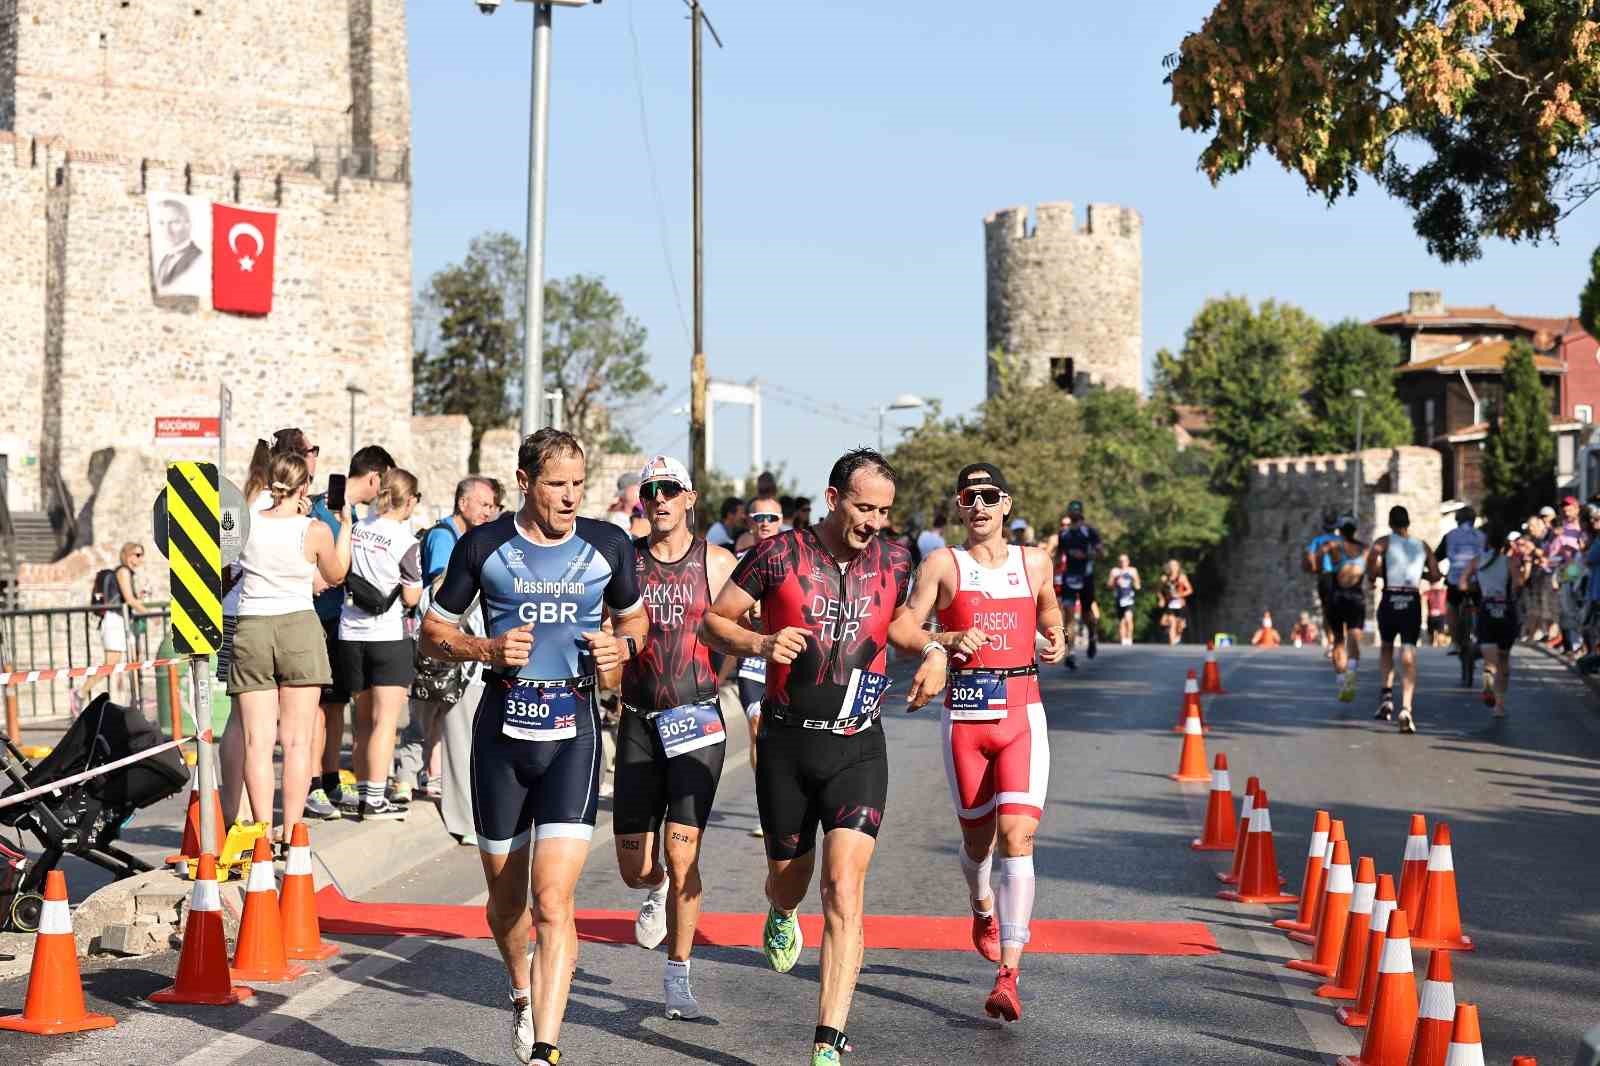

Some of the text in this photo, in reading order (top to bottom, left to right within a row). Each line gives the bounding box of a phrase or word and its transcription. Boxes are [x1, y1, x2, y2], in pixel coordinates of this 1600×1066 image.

[352, 526, 391, 546] AUSTRIA
[514, 577, 585, 598] Massingham
[643, 583, 693, 604] AKKAN
[518, 601, 578, 624] GBR
[649, 604, 685, 625] TUR
[811, 595, 872, 620] DENIZ
[818, 620, 860, 641] TUR
[973, 612, 1018, 632] PIASECKI
[861, 674, 880, 714] 3155
[952, 687, 984, 701] 3024
[506, 699, 550, 718] 3380
[660, 717, 698, 738] 3052
